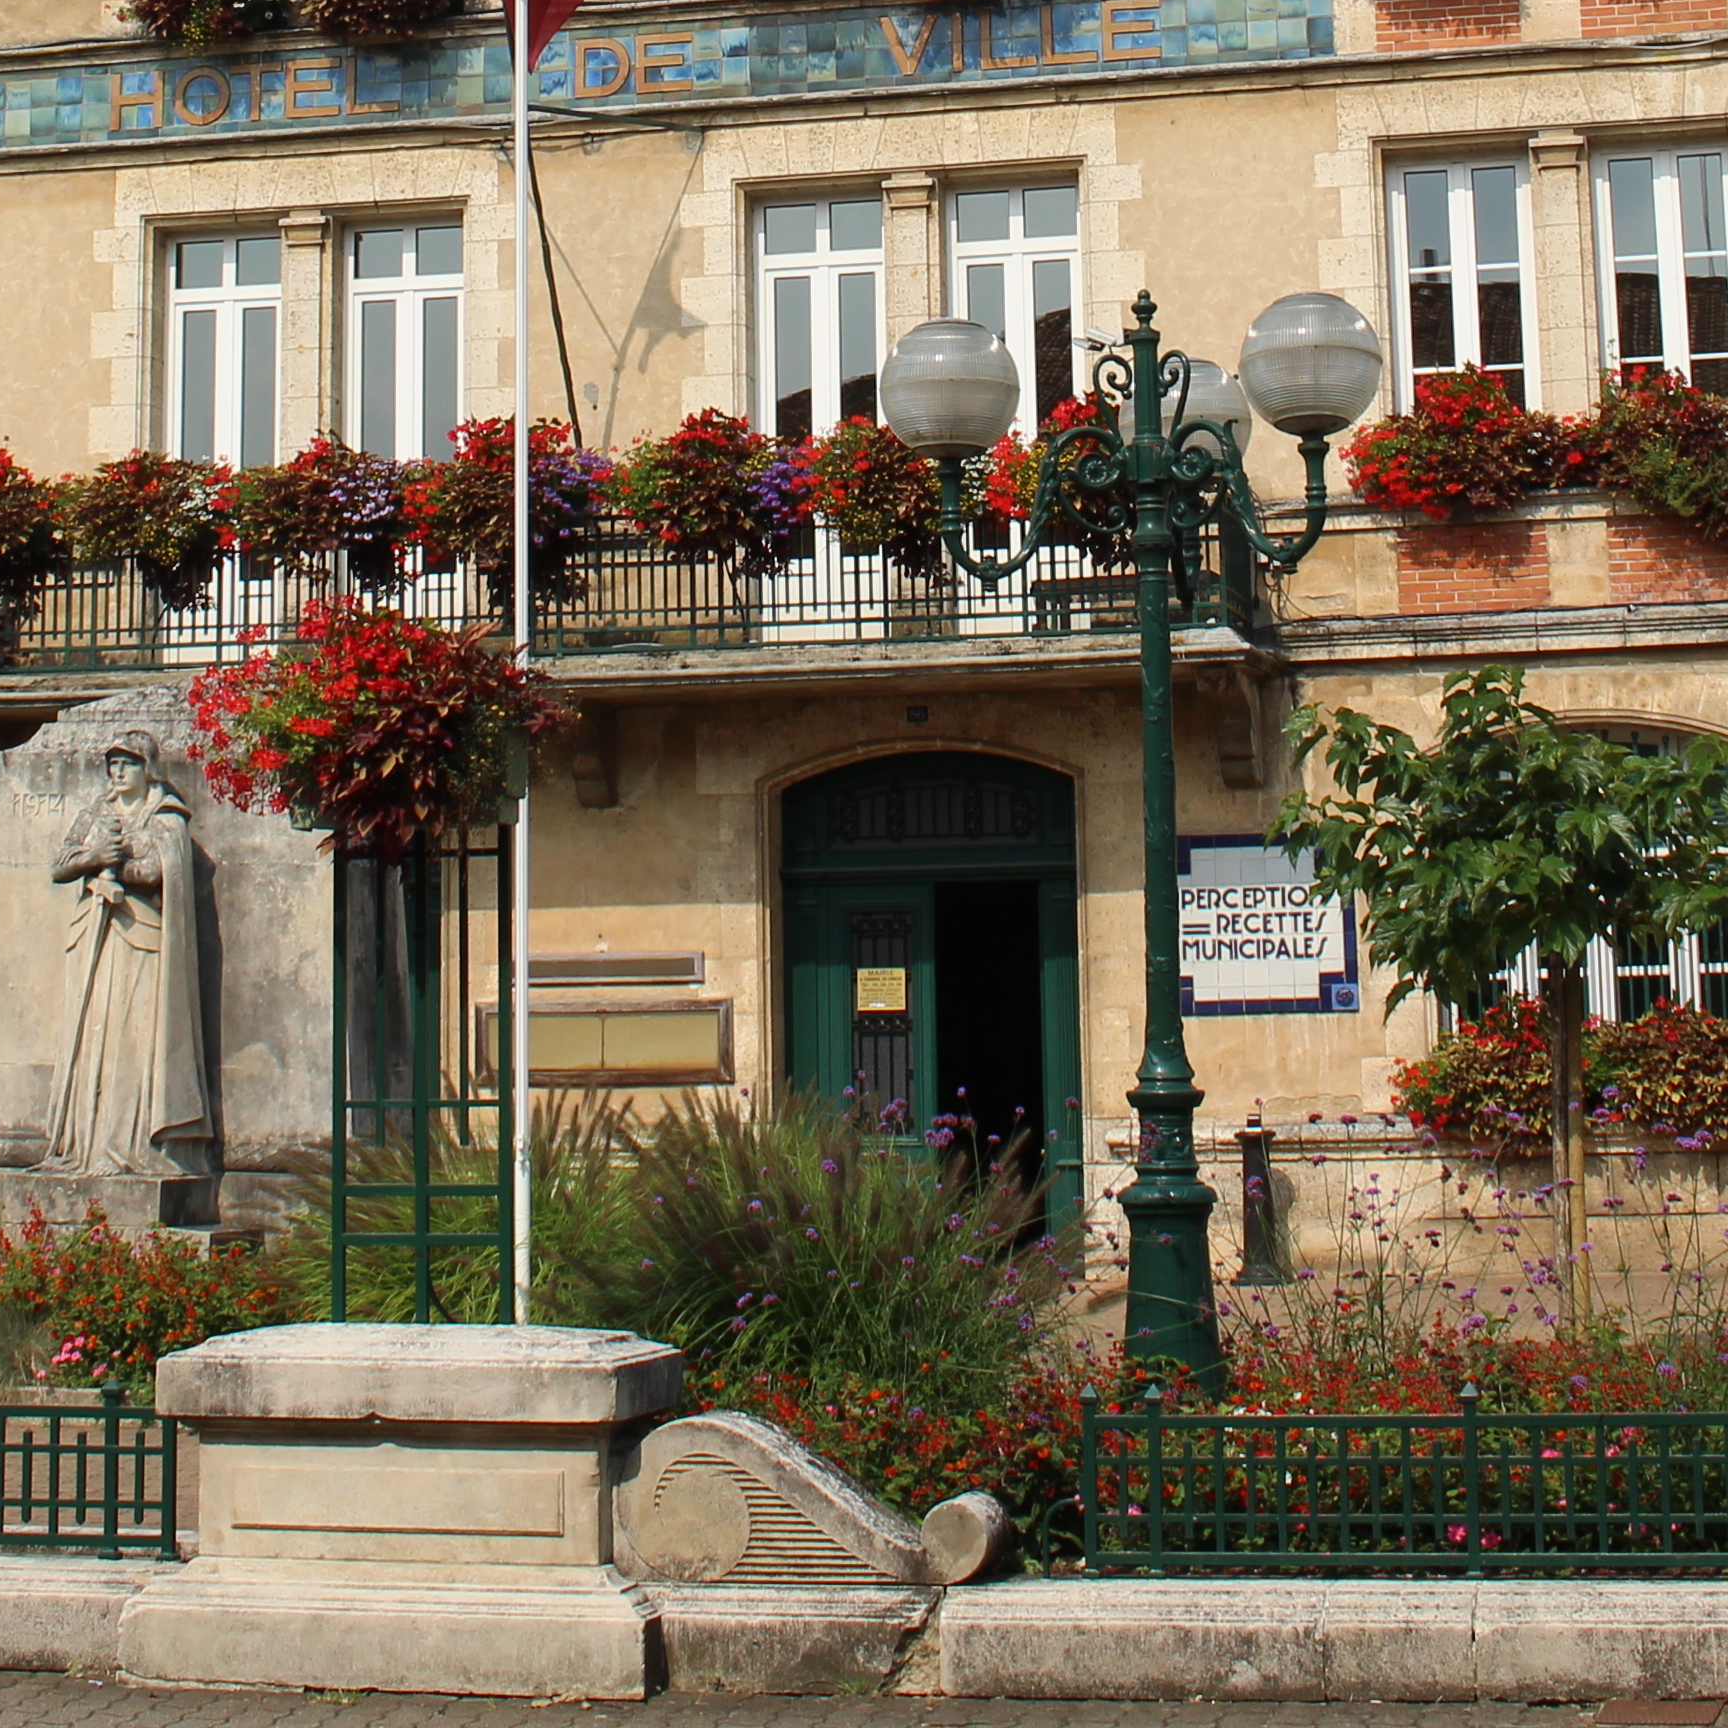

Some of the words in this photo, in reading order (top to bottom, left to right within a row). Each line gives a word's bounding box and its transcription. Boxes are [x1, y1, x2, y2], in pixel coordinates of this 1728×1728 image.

[108, 55, 400, 132] HOTEL
[573, 32, 694, 99] DE
[13, 793, 66, 818] 1914
[1216, 911, 1327, 934] RECETTES
[1182, 936, 1328, 961] MUNICIPALES
